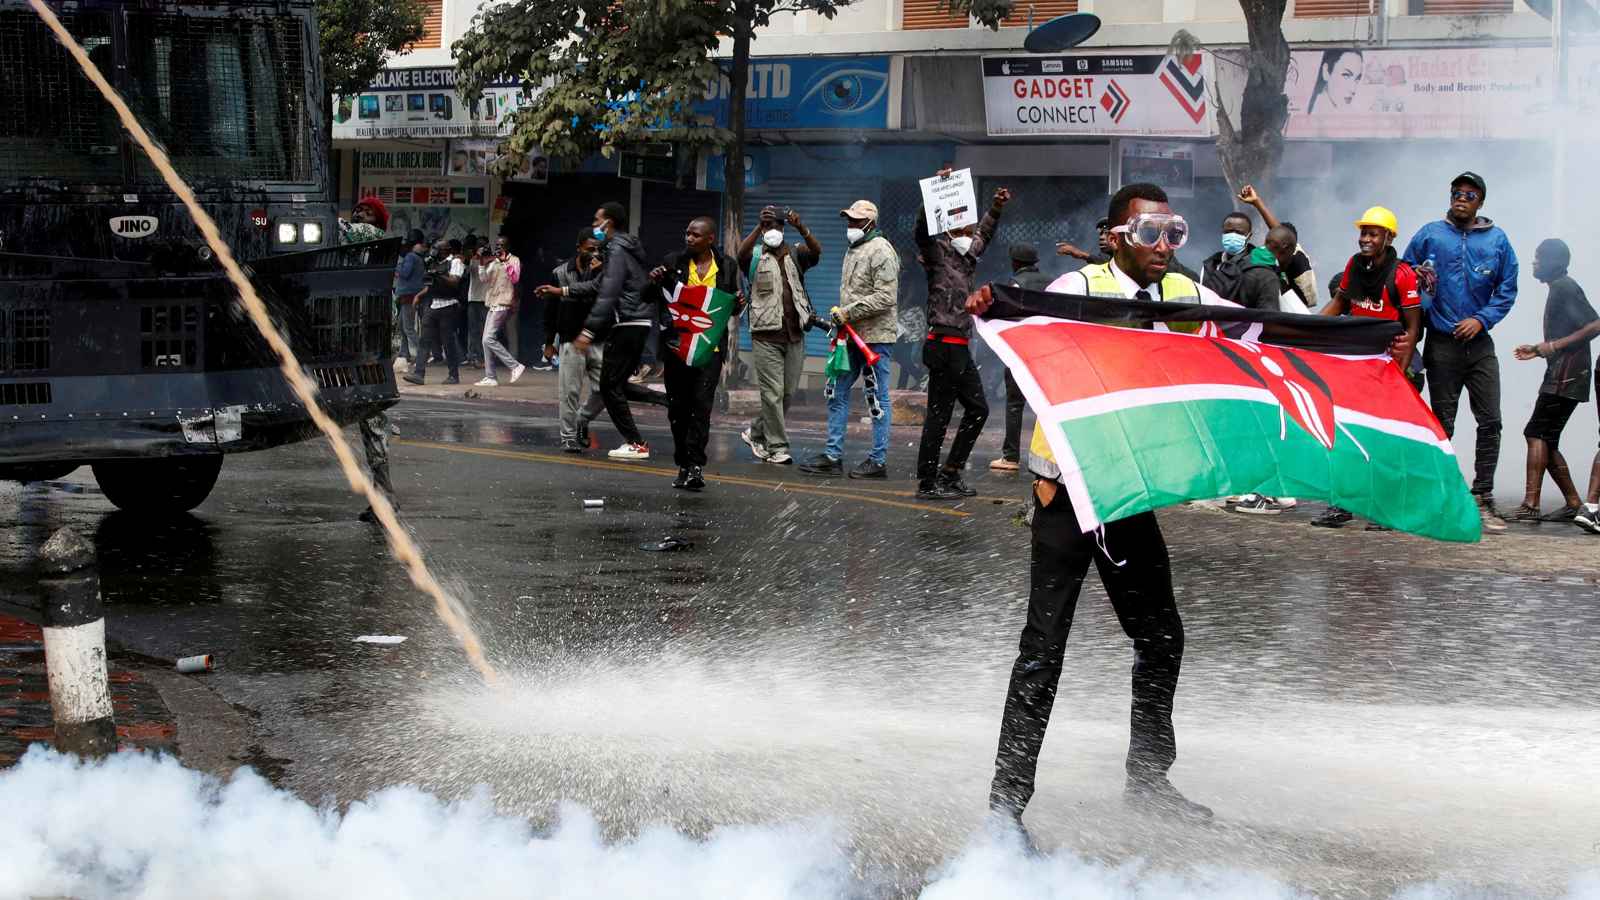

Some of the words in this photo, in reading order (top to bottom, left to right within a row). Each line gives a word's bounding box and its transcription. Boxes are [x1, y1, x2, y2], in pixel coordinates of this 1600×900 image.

[745, 63, 791, 99] LTD
[1014, 78, 1094, 99] GADGET
[1413, 82, 1436, 93] Body
[1438, 82, 1454, 92] and
[1456, 82, 1487, 93] Beauty
[1017, 105, 1096, 124] CONNECT
[431, 126, 447, 136] SMART
[362, 151, 394, 168] CENTRAL
[396, 151, 420, 168] FOREX
[422, 151, 443, 168] BURE
[118, 220, 151, 233] JINO
